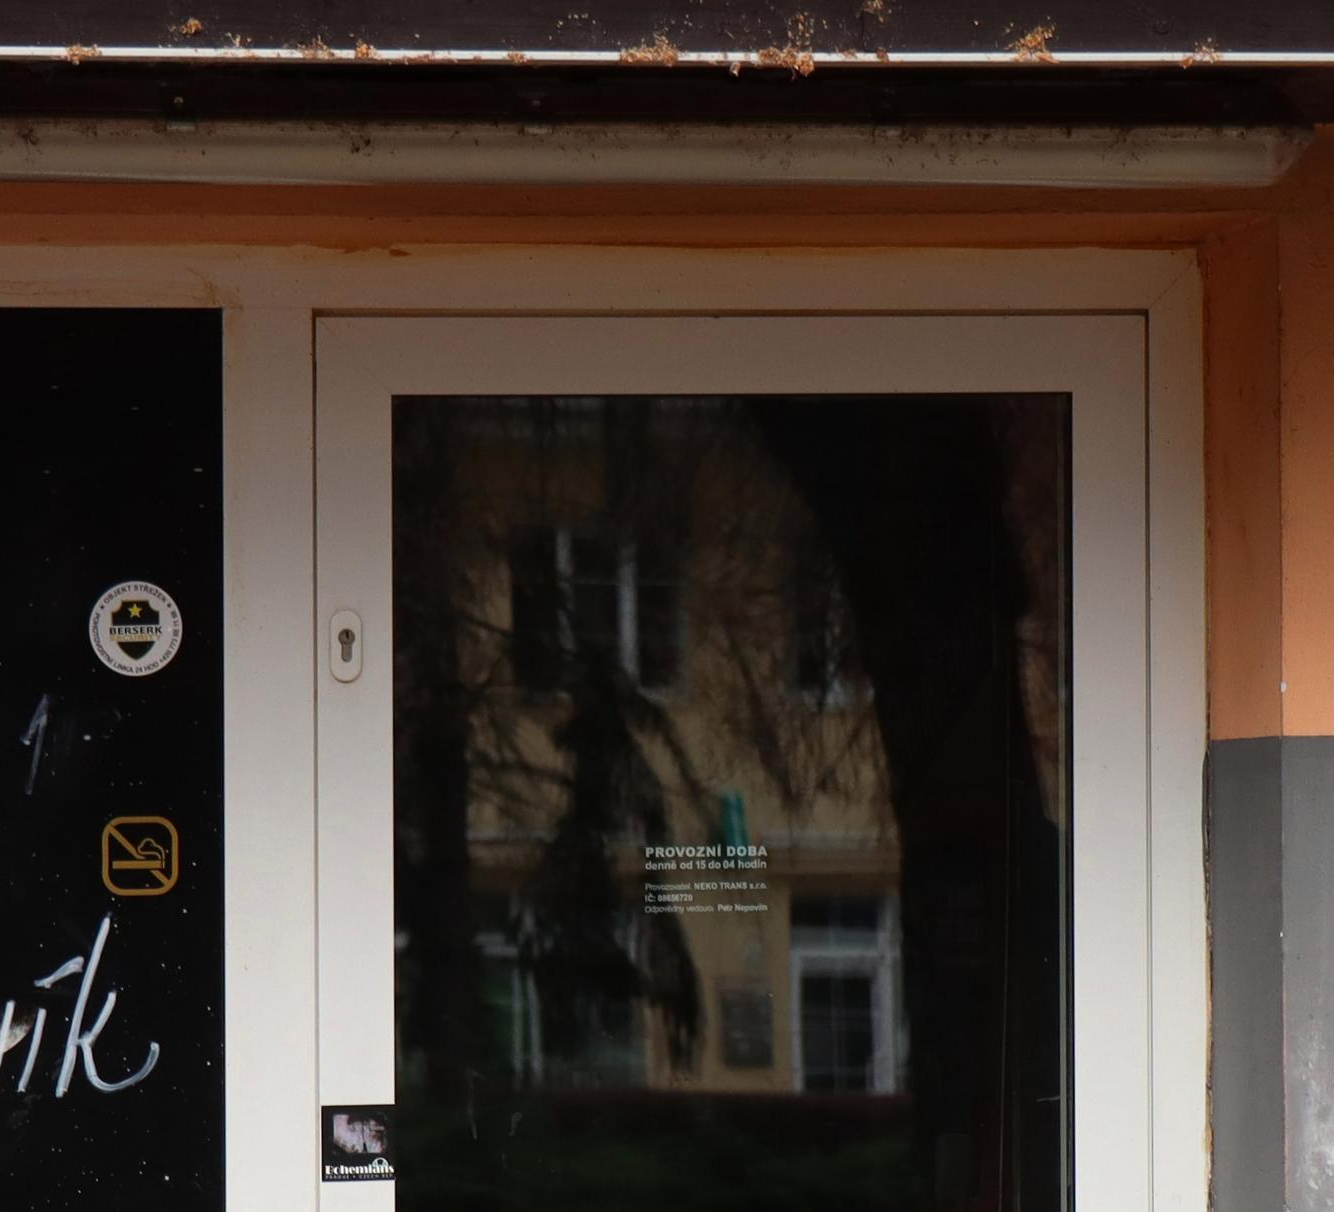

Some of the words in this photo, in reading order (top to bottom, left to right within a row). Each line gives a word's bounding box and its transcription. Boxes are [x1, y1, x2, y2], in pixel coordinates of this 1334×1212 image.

[109, 626, 162, 635] BERSERK
[645, 844, 721, 858] PROVOZNÍ
[726, 845, 768, 857] DOBA
[645, 860, 677, 871] denně
[679, 860, 693, 870] od
[696, 860, 706, 870] 15
[708, 860, 721, 869] do
[723, 860, 735, 869] 04
[738, 859, 767, 869] hodin
[693, 882, 718, 890] NEKO
[720, 882, 747, 890] TRANS
